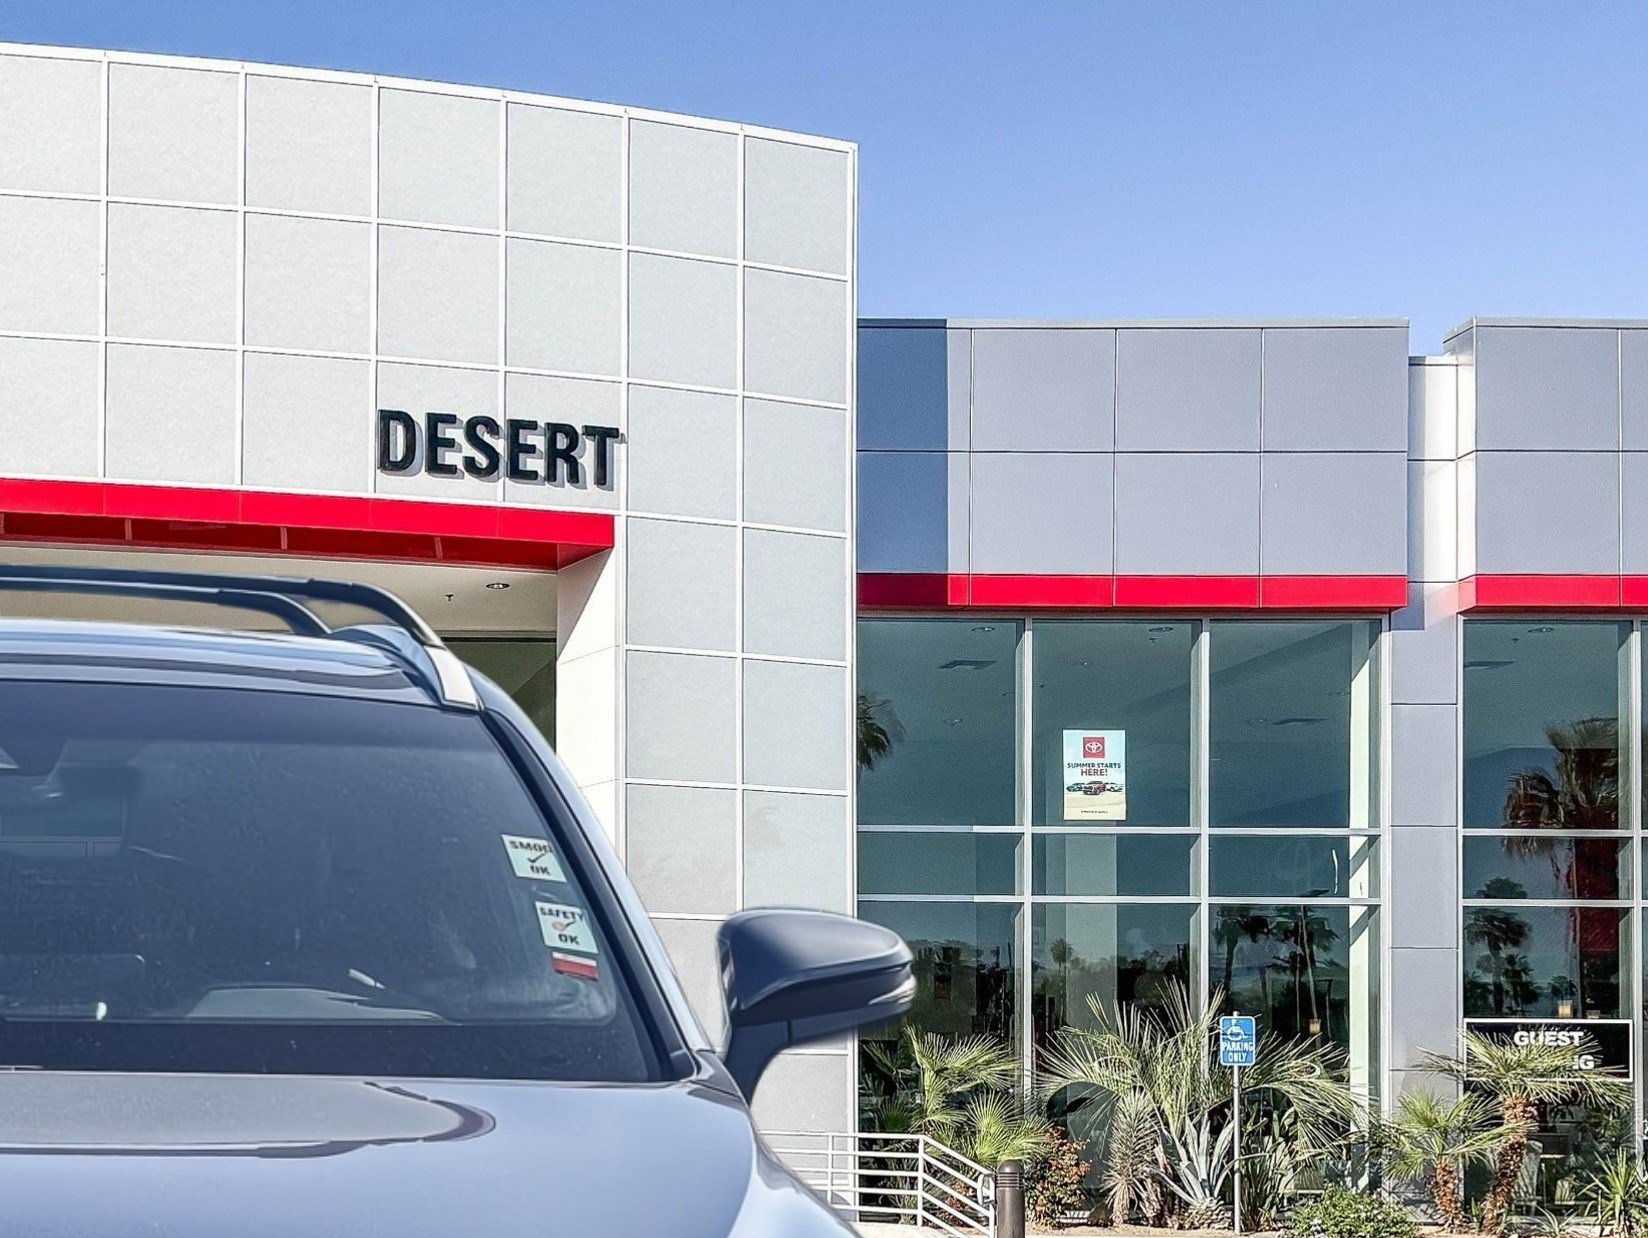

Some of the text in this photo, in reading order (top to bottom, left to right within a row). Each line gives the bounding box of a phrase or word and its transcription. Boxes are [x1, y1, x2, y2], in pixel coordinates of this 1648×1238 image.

[377, 409, 621, 487] DESERT
[1080, 769, 1108, 777] HERE!
[529, 865, 551, 875] OK
[539, 907, 584, 921] SAFETY
[557, 934, 580, 945] OK
[1514, 1031, 1585, 1047] GUEST
[1222, 1042, 1254, 1052] PARKING
[1228, 1052, 1247, 1062] ONLY
